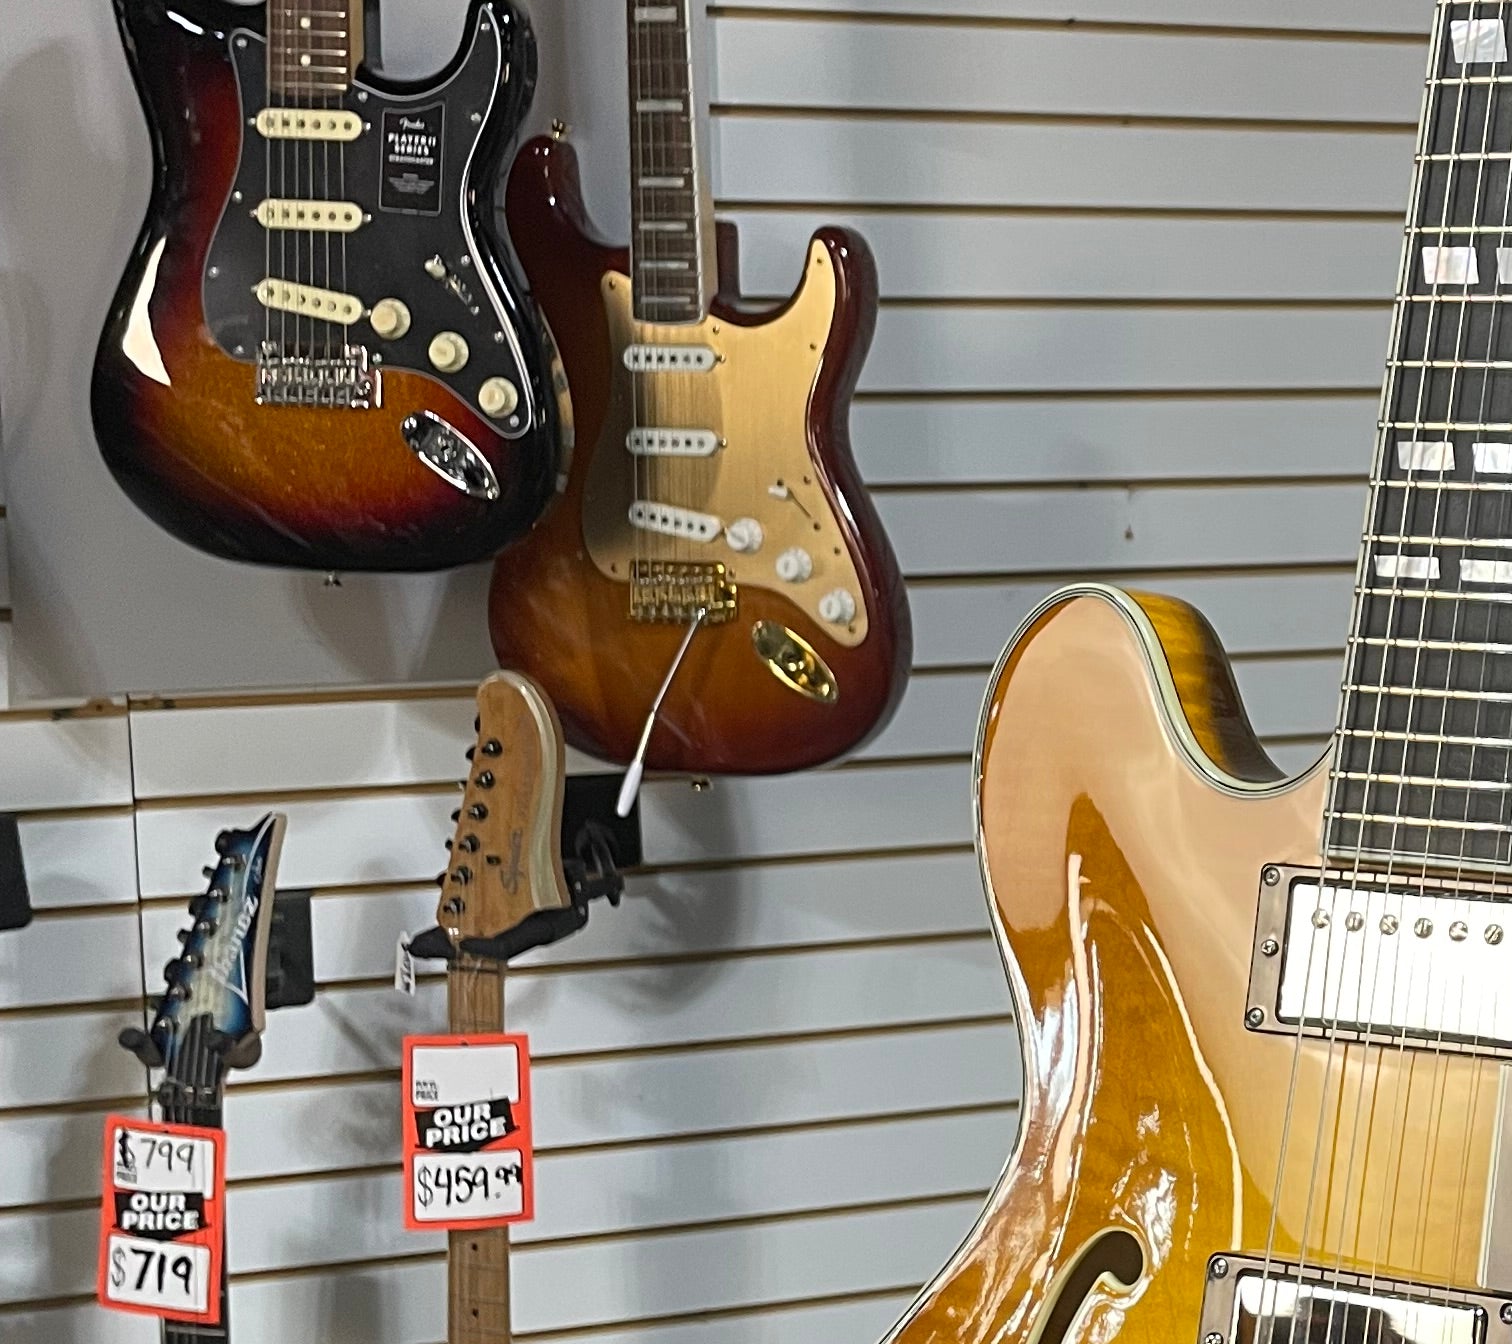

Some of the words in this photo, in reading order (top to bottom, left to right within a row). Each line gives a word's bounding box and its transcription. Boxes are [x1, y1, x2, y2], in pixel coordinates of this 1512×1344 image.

[433, 1102, 491, 1129] OUR
[425, 1116, 507, 1149] PRICE
[130, 1192, 186, 1212] OUR
[121, 1209, 200, 1231] PRICE
[111, 1246, 191, 1295] $719
